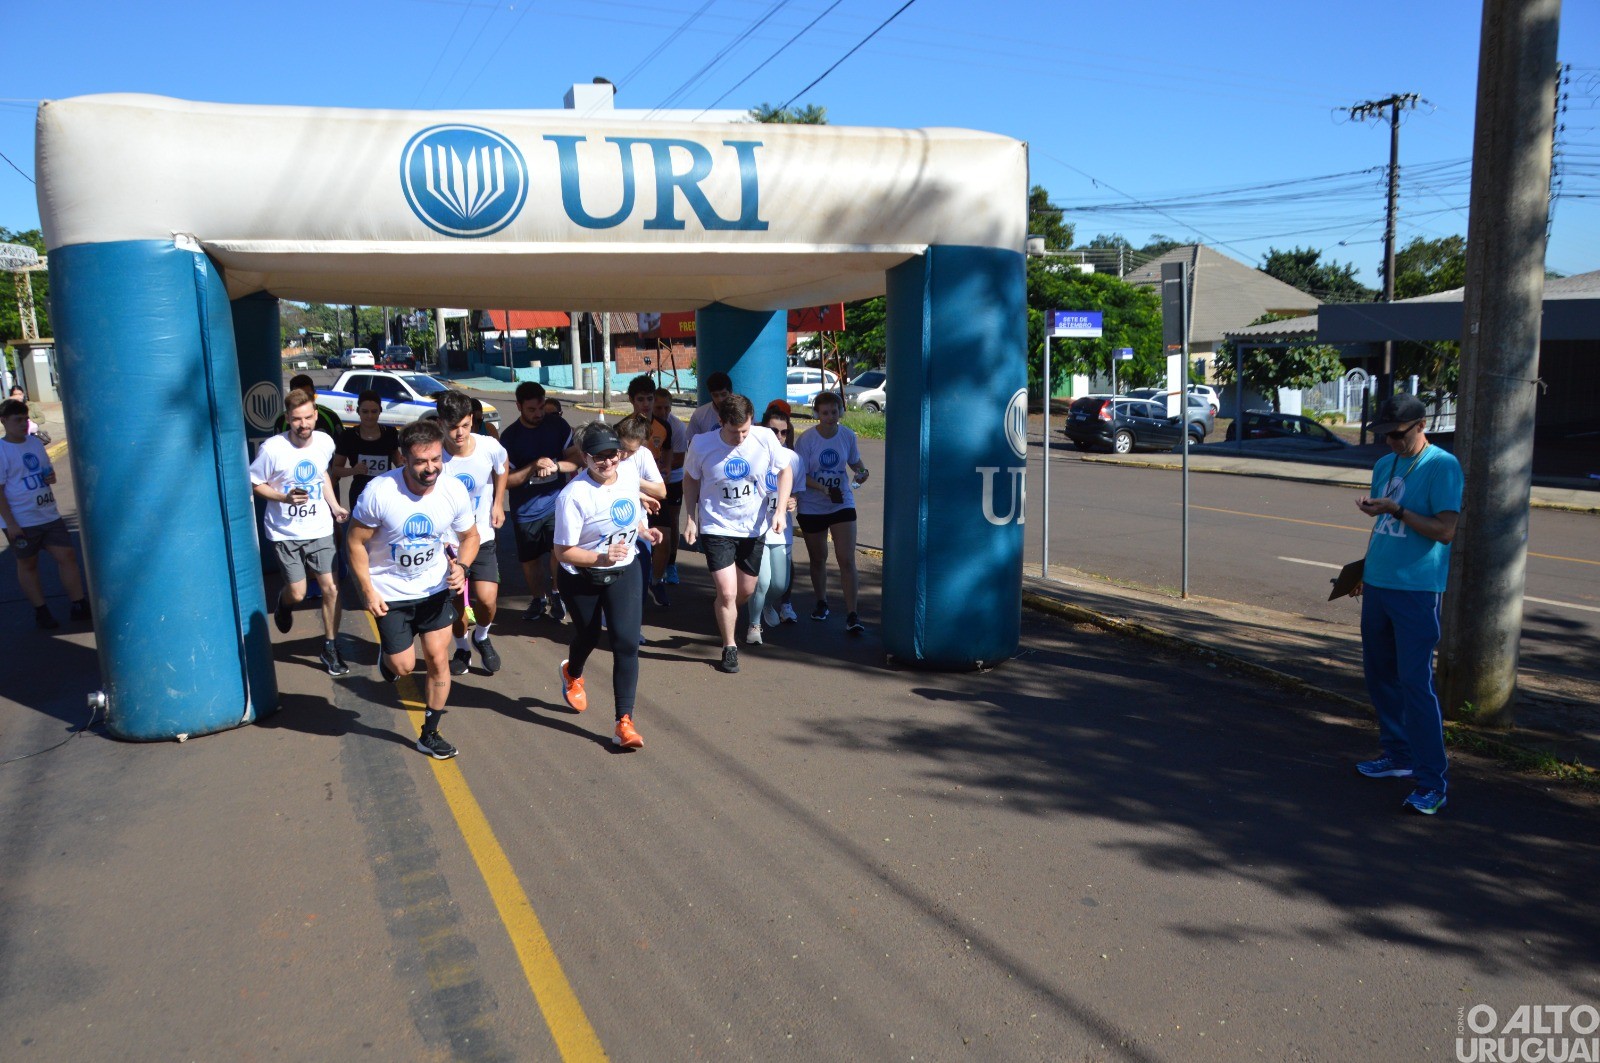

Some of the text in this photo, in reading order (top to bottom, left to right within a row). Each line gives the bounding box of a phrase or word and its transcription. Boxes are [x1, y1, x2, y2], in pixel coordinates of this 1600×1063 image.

[542, 134, 770, 231] URI
[722, 484, 752, 499] 114
[288, 503, 317, 518] 064
[399, 548, 435, 568] 068
